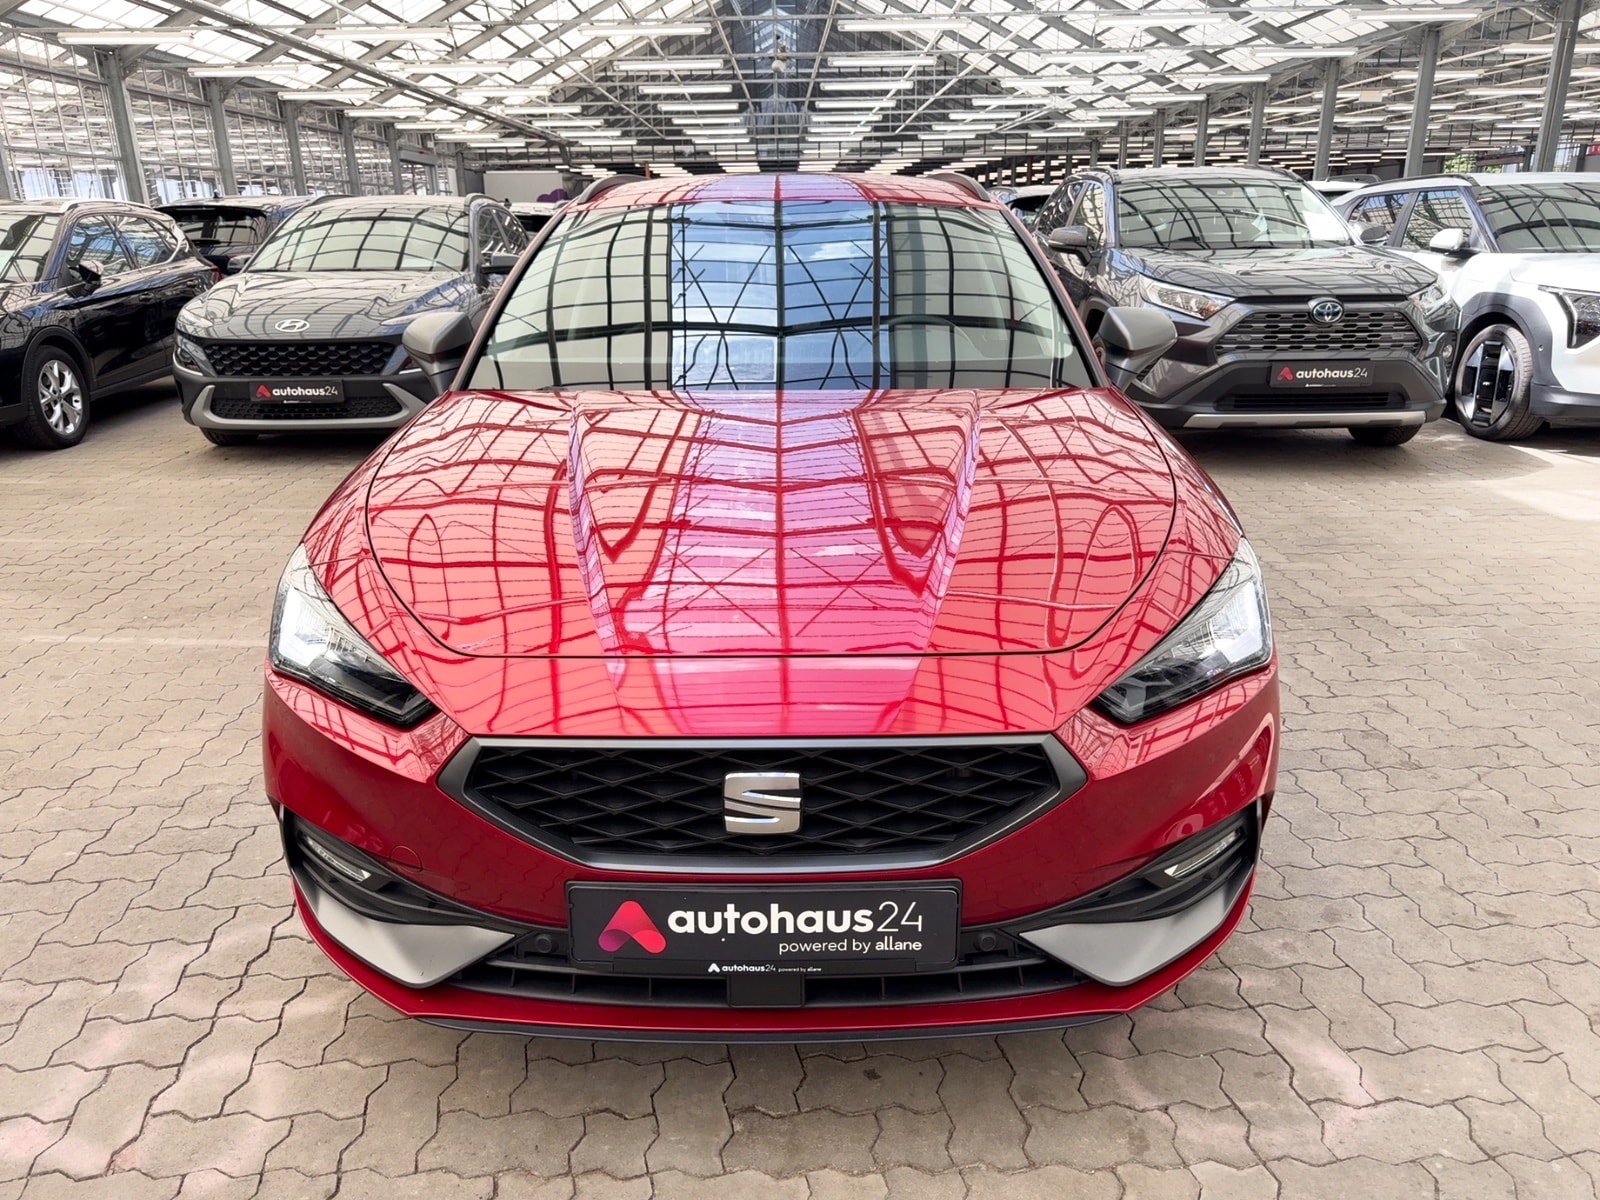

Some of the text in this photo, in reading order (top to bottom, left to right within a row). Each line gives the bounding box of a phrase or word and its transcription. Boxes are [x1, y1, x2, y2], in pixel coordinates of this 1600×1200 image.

[1296, 367, 1368, 379] autohaus24
[272, 386, 338, 396] autohaus24
[668, 901, 923, 934] autohaus24
[778, 937, 922, 955] powered by allane
[722, 964, 776, 972] autohaus24
